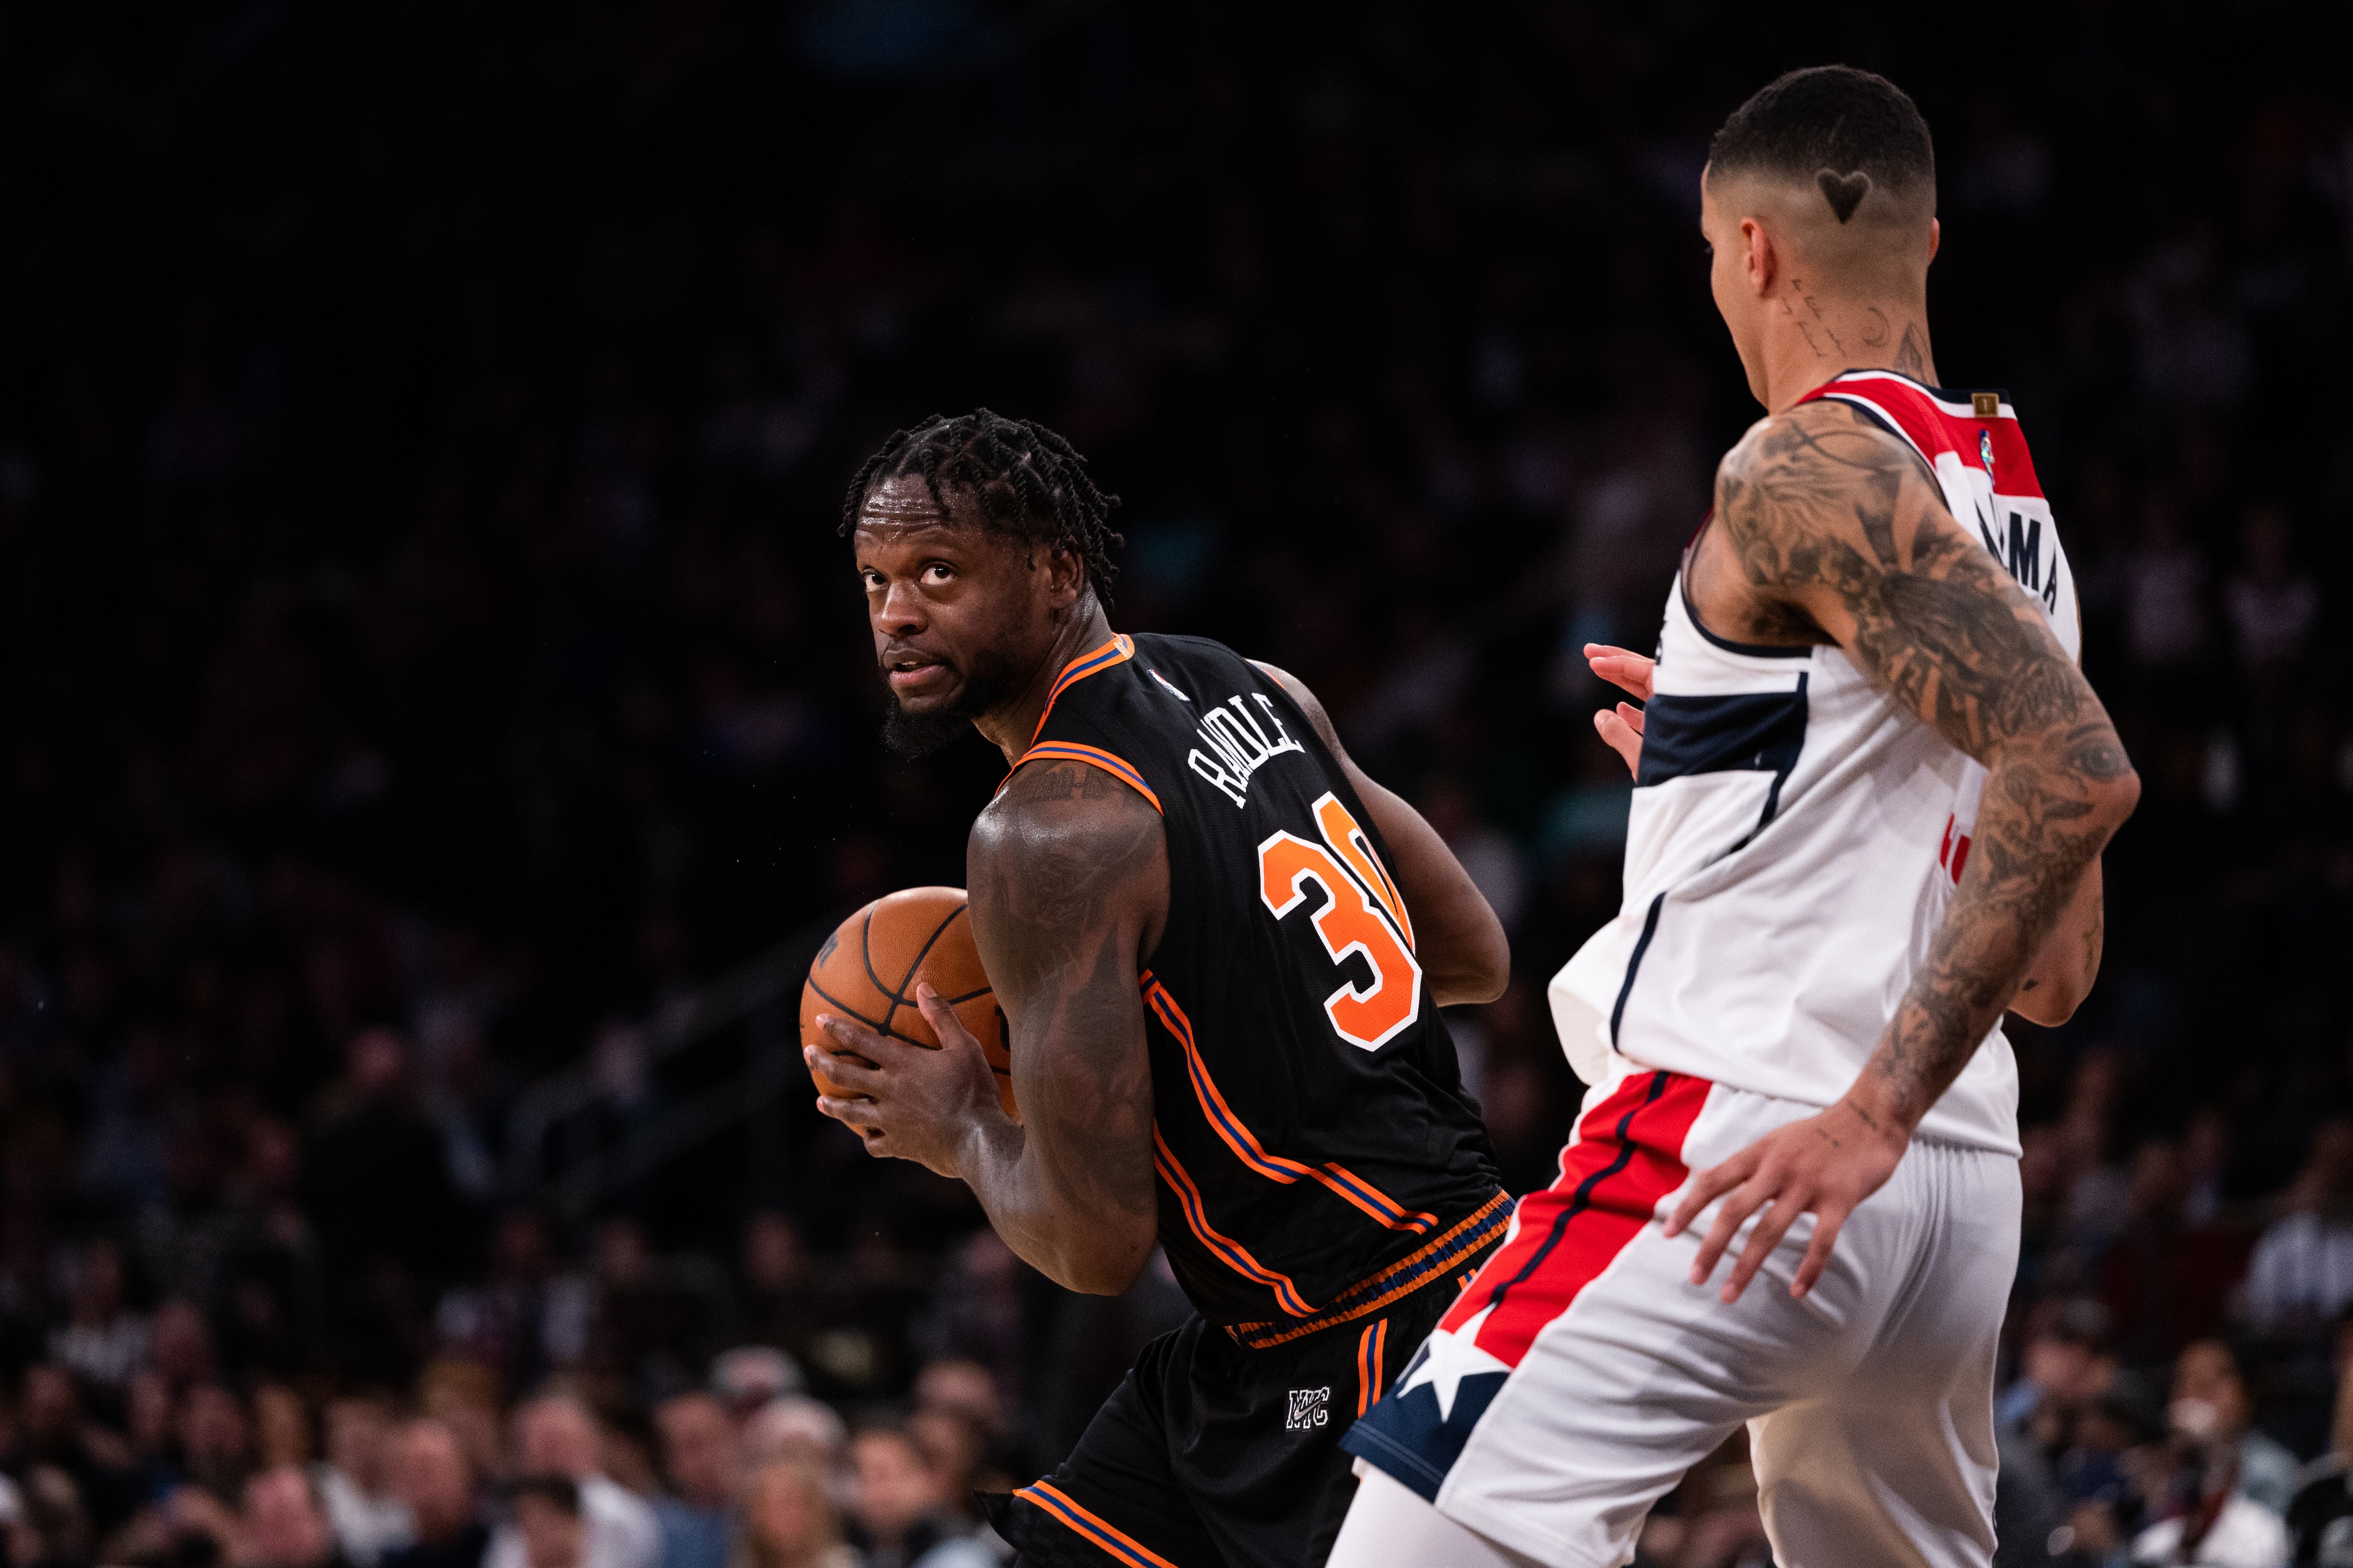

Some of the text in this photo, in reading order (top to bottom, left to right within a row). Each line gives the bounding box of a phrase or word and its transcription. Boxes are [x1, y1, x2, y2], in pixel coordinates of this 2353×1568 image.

[1188, 690, 1306, 809] RANDLE
[1257, 791, 1423, 1052] 30
[1385, 1263, 1419, 1291] YORK
[1286, 1386, 1330, 1429] NYC
